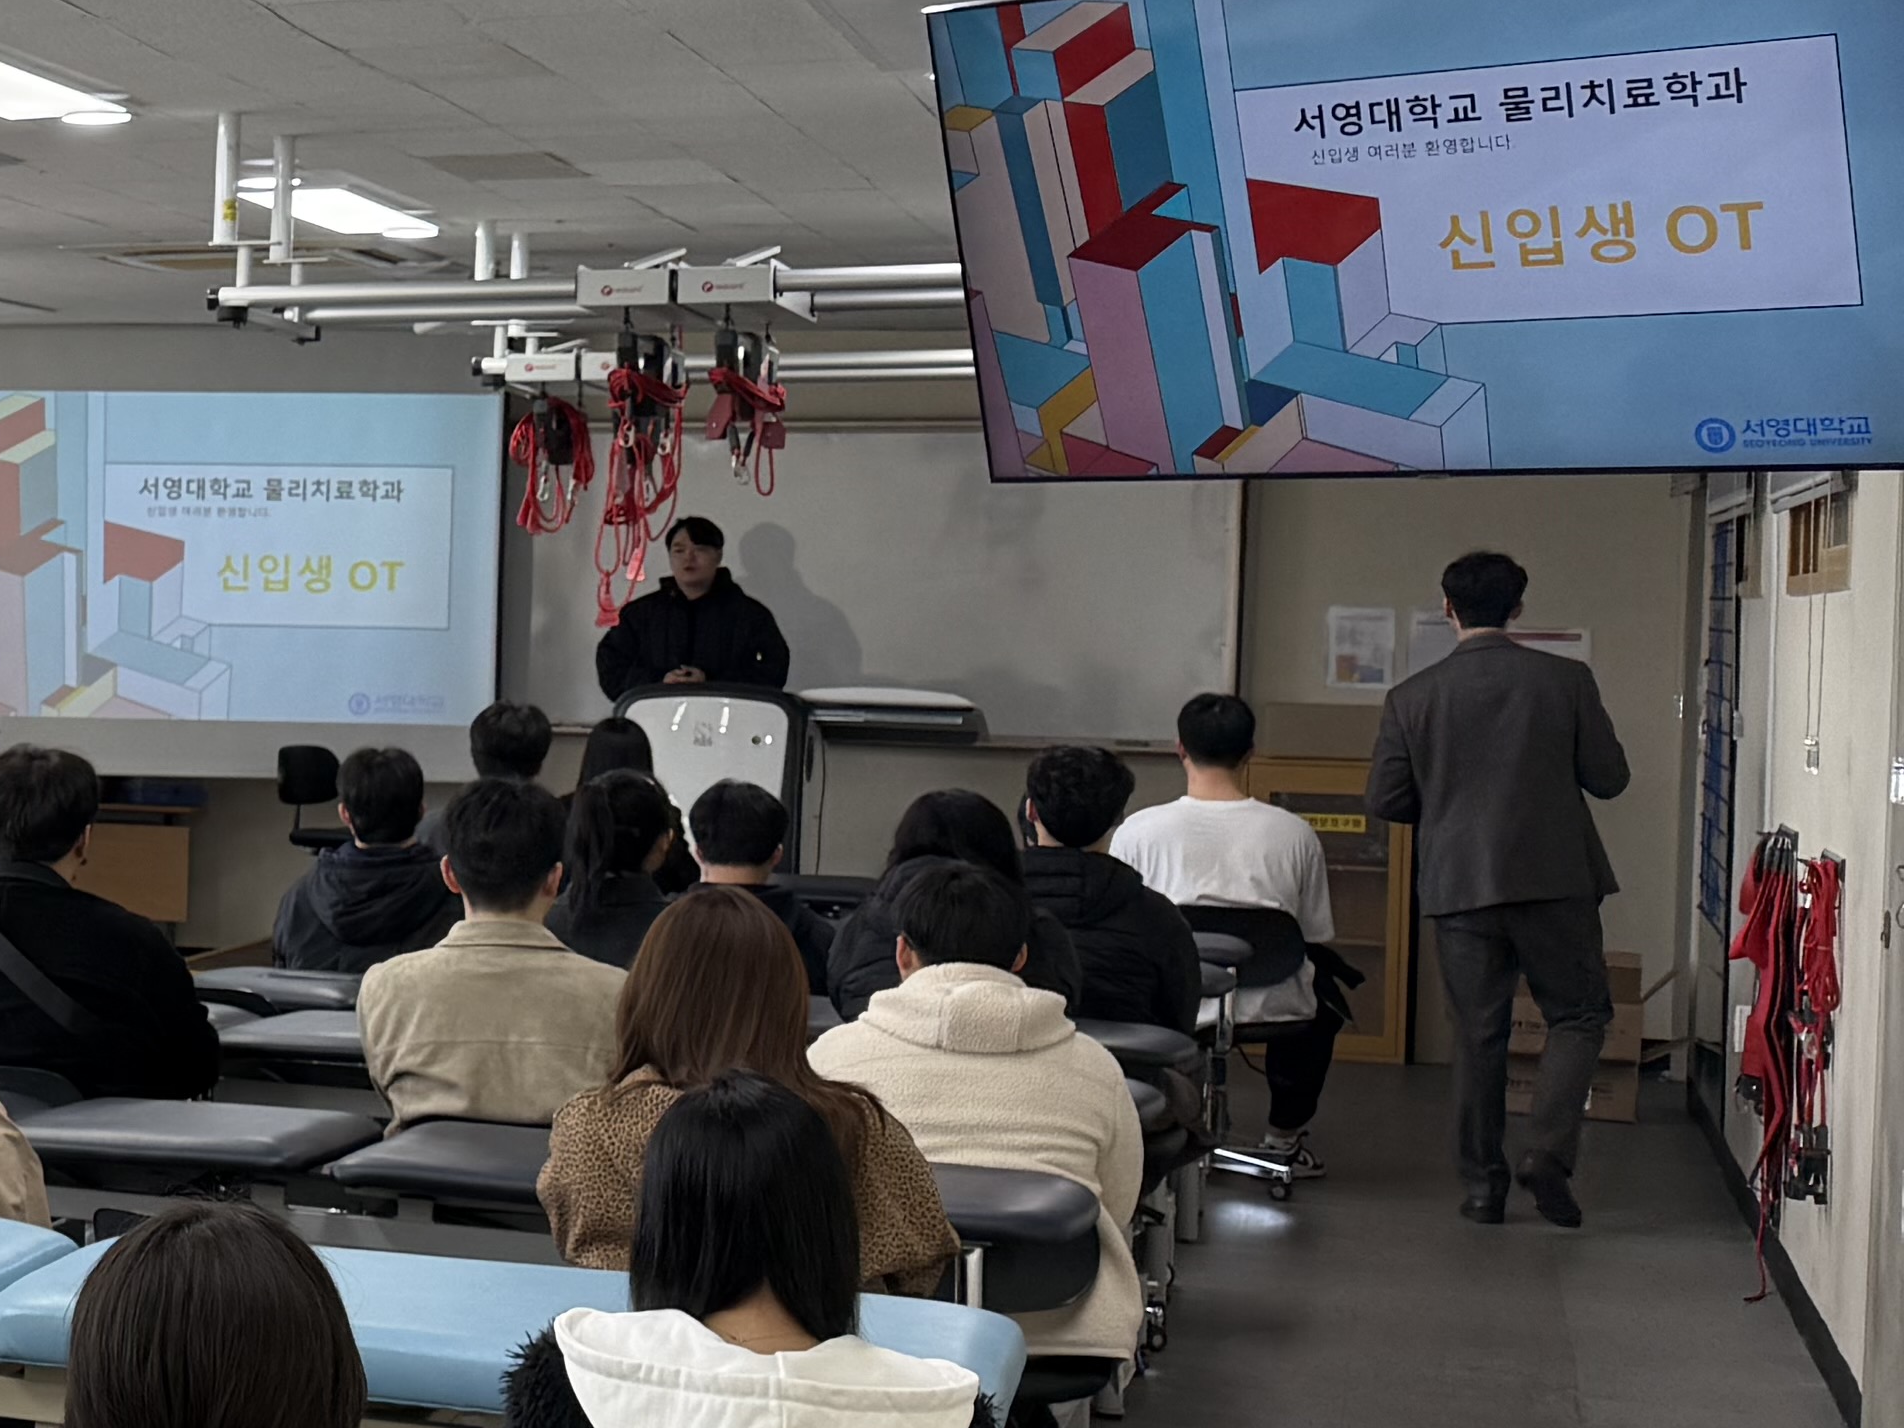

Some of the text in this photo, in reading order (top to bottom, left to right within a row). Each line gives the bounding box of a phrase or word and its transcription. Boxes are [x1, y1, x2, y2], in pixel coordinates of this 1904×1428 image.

[1293, 66, 1748, 139] 서영대학교 물리치료학과
[1311, 145, 1360, 166] 신입생
[1367, 141, 1418, 161] 여러분
[1437, 200, 1765, 271] 신입생 OT
[1742, 416, 1872, 438] 서영대학교
[138, 477, 404, 502] 서영대학교 물리치료학과
[218, 554, 405, 594] 신입생 OT
